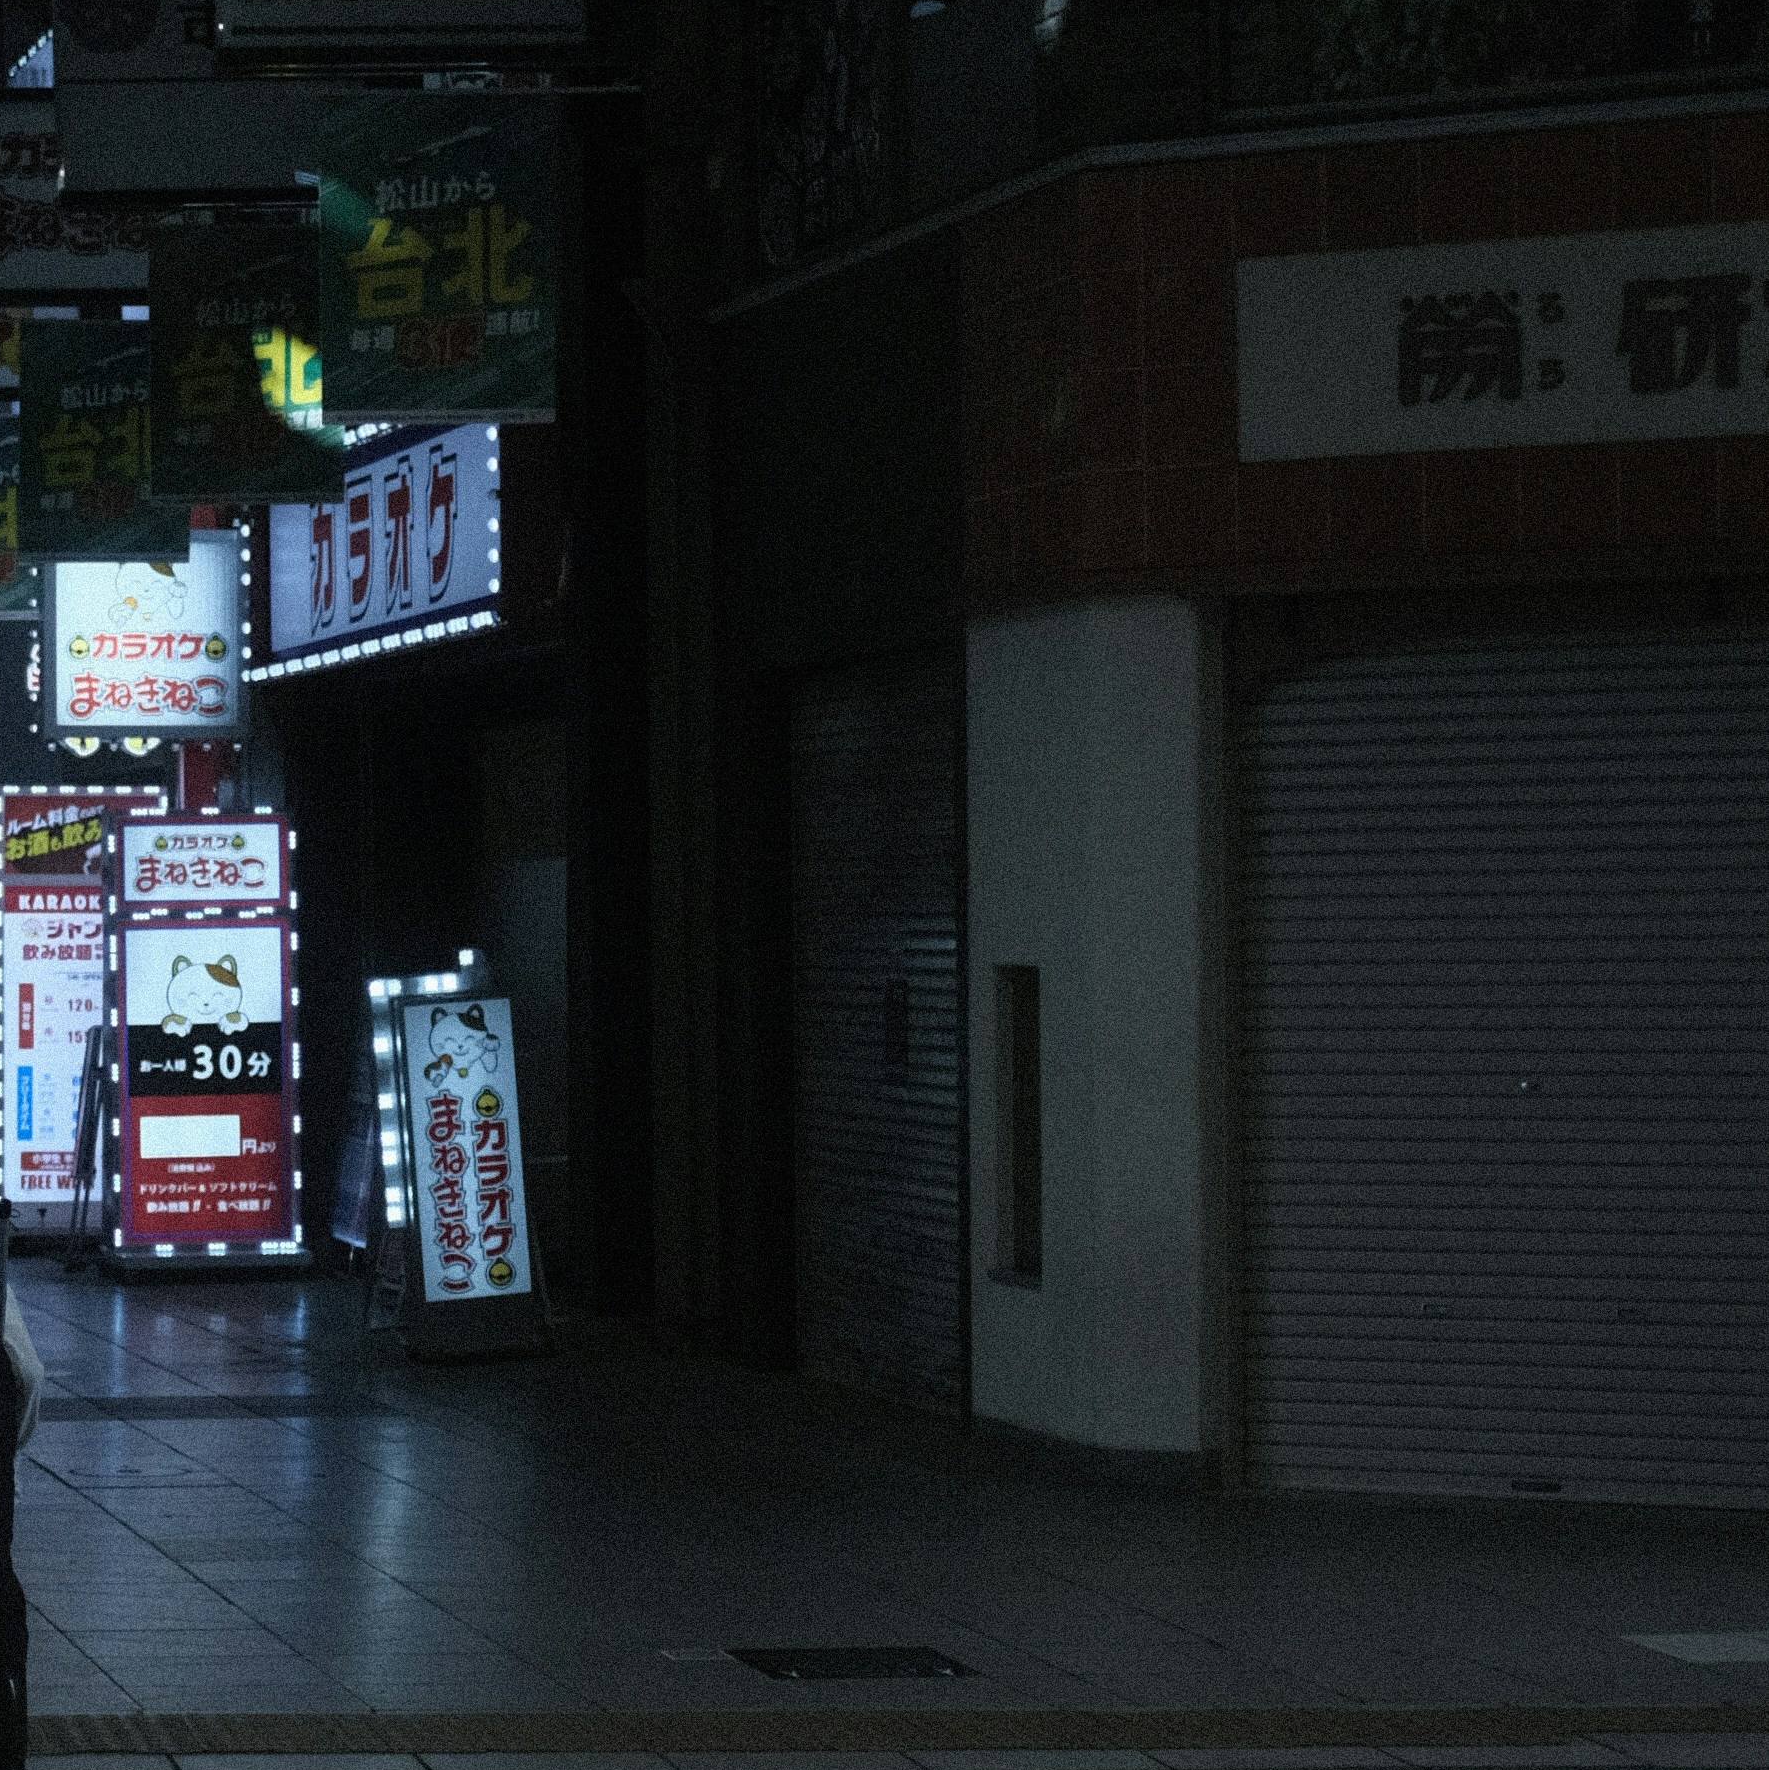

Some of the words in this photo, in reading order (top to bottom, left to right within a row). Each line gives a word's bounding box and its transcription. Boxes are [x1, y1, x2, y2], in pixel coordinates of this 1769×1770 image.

[375, 170, 498, 212] 松山から
[345, 204, 535, 319] 台北
[310, 444, 458, 637] カラオケ
[92, 632, 205, 660] カラオケ
[68, 671, 227, 719] まねきねこ
[5, 818, 103, 862] お酒も飲み
[171, 835, 229, 850] カラオケ
[135, 854, 266, 893] まねきねこ
[18, 894, 102, 911] KARAOK
[67, 998, 94, 1013] 120
[191, 1043, 273, 1081] 30分
[241, 1137, 277, 1156] 円より
[20, 1174, 52, 1190] FREE
[429, 1092, 473, 1293] まねきねこ
[473, 1118, 514, 1257] カラオケ
